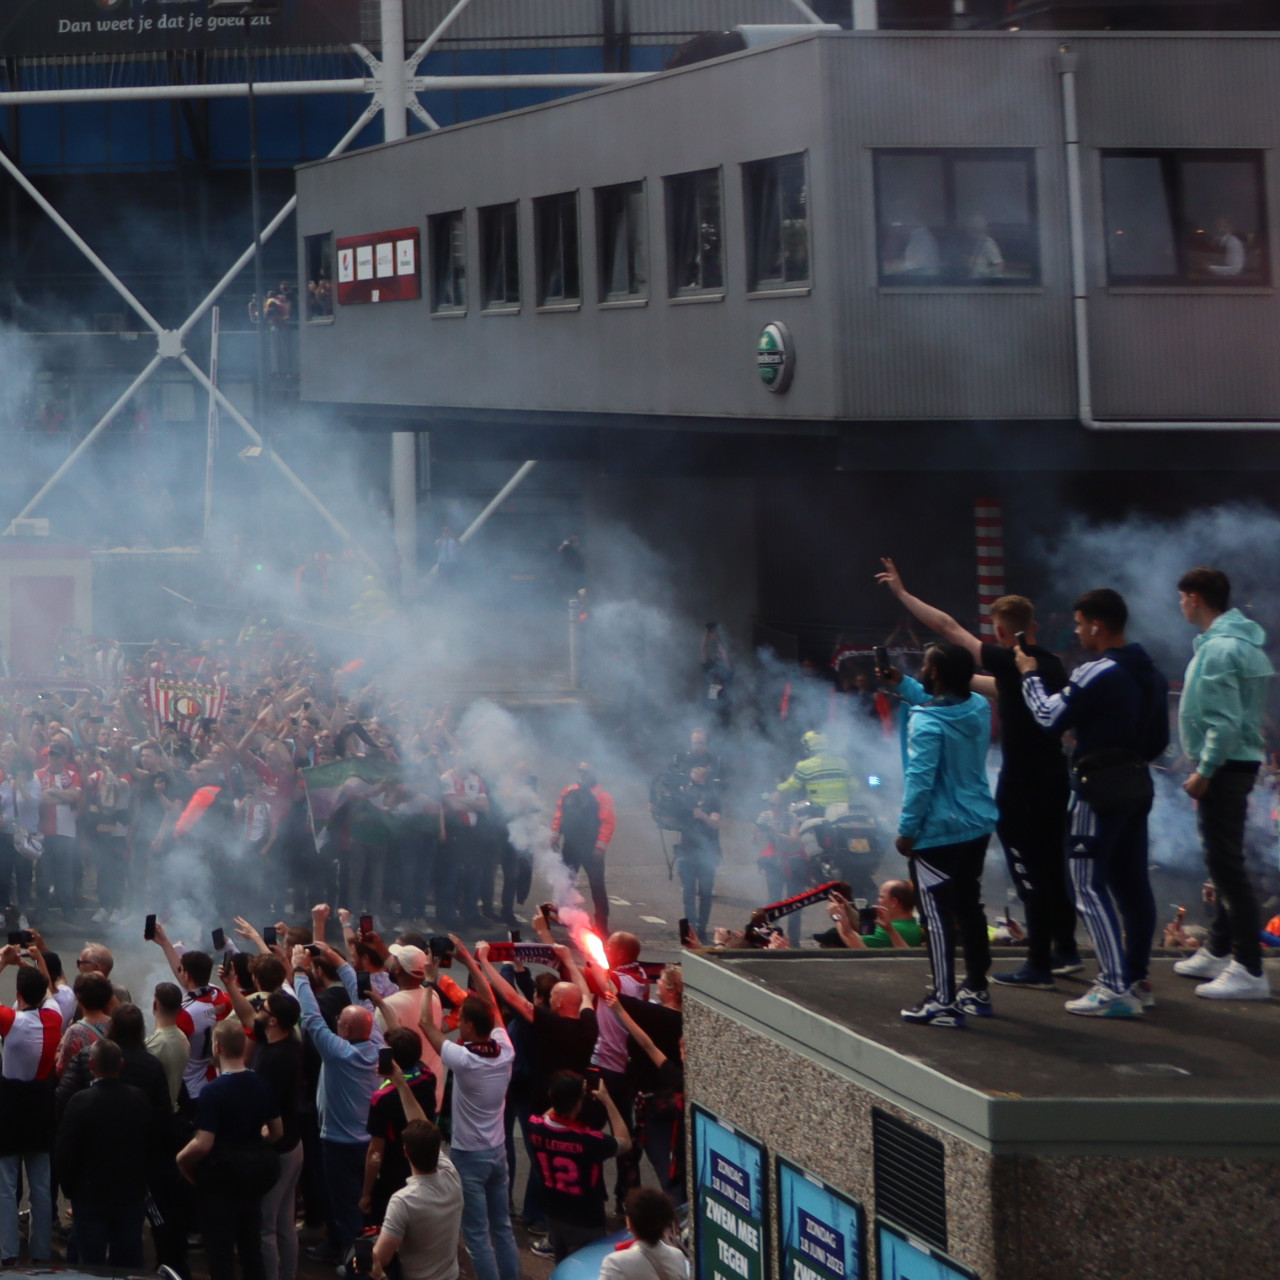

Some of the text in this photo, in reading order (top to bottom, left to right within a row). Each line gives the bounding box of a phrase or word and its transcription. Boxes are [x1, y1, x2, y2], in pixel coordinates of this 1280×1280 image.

[58, 19, 91, 33] Dan
[96, 18, 134, 31] weet
[137, 16, 153, 34] je
[157, 14, 184, 29] dat
[188, 13, 203, 33] je
[536, 1151, 584, 1196] 12
[717, 1158, 744, 1187] ZONDAG
[720, 1180, 735, 1200] JUNI
[735, 1190, 750, 1211] 2023
[705, 1196, 758, 1252] ZWEM MEE
[805, 1217, 837, 1249] ZONDAG
[717, 1237, 749, 1280] TEGEN
[800, 1236, 845, 1276] 18 JUNI 2023
